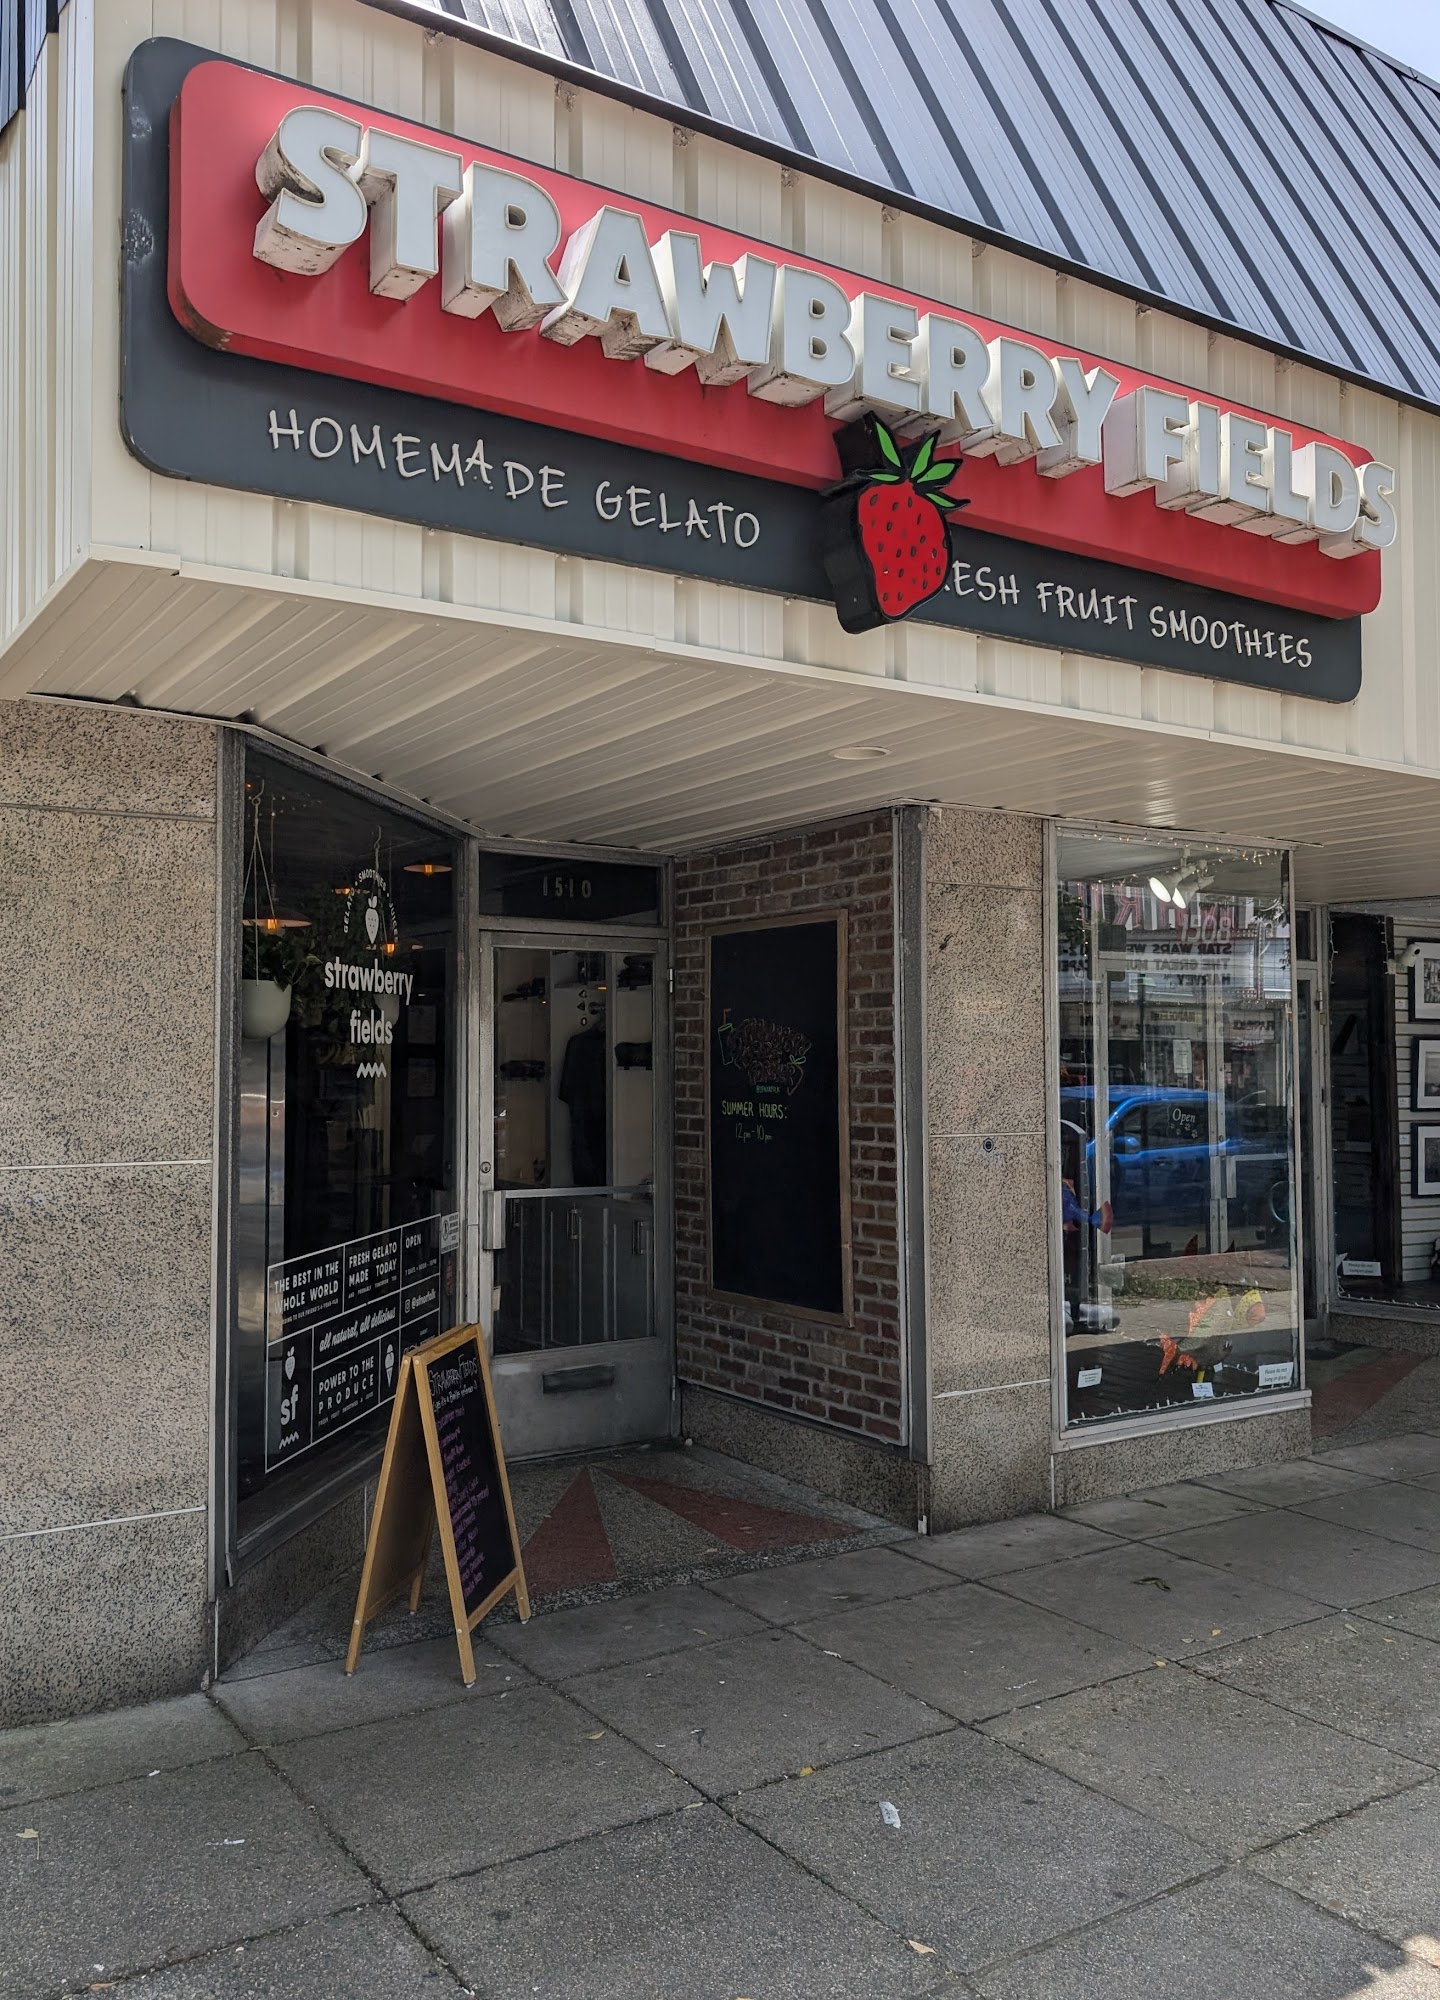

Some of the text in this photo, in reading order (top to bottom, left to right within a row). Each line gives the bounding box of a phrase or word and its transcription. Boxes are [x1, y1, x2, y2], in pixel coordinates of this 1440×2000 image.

[260, 105, 1397, 556] STRAWBERRY FIELDS
[268, 407, 761, 549] HOMEMADE GELATO
[945, 560, 1312, 668] ESH FRUIT SMOOTHIES
[543, 876, 592, 899] 1510
[324, 956, 414, 1006] strawberry
[349, 1009, 394, 1044] fields
[722, 1100, 788, 1119] SUMMER HOURS:
[1172, 1108, 1196, 1125] Open
[349, 1242, 397, 1268] FRESH GELATO
[405, 1233, 422, 1249] OPEN
[274, 1260, 339, 1293] THE BEST IN THE
[348, 1258, 397, 1287] MADE TODAY
[274, 1280, 339, 1314] WHOLE WORLD
[319, 1307, 396, 1352] all natural, all delicious
[319, 1355, 374, 1395] POWER TO THE
[280, 1383, 299, 1425] sf
[318, 1373, 374, 1415] PRODUCE
